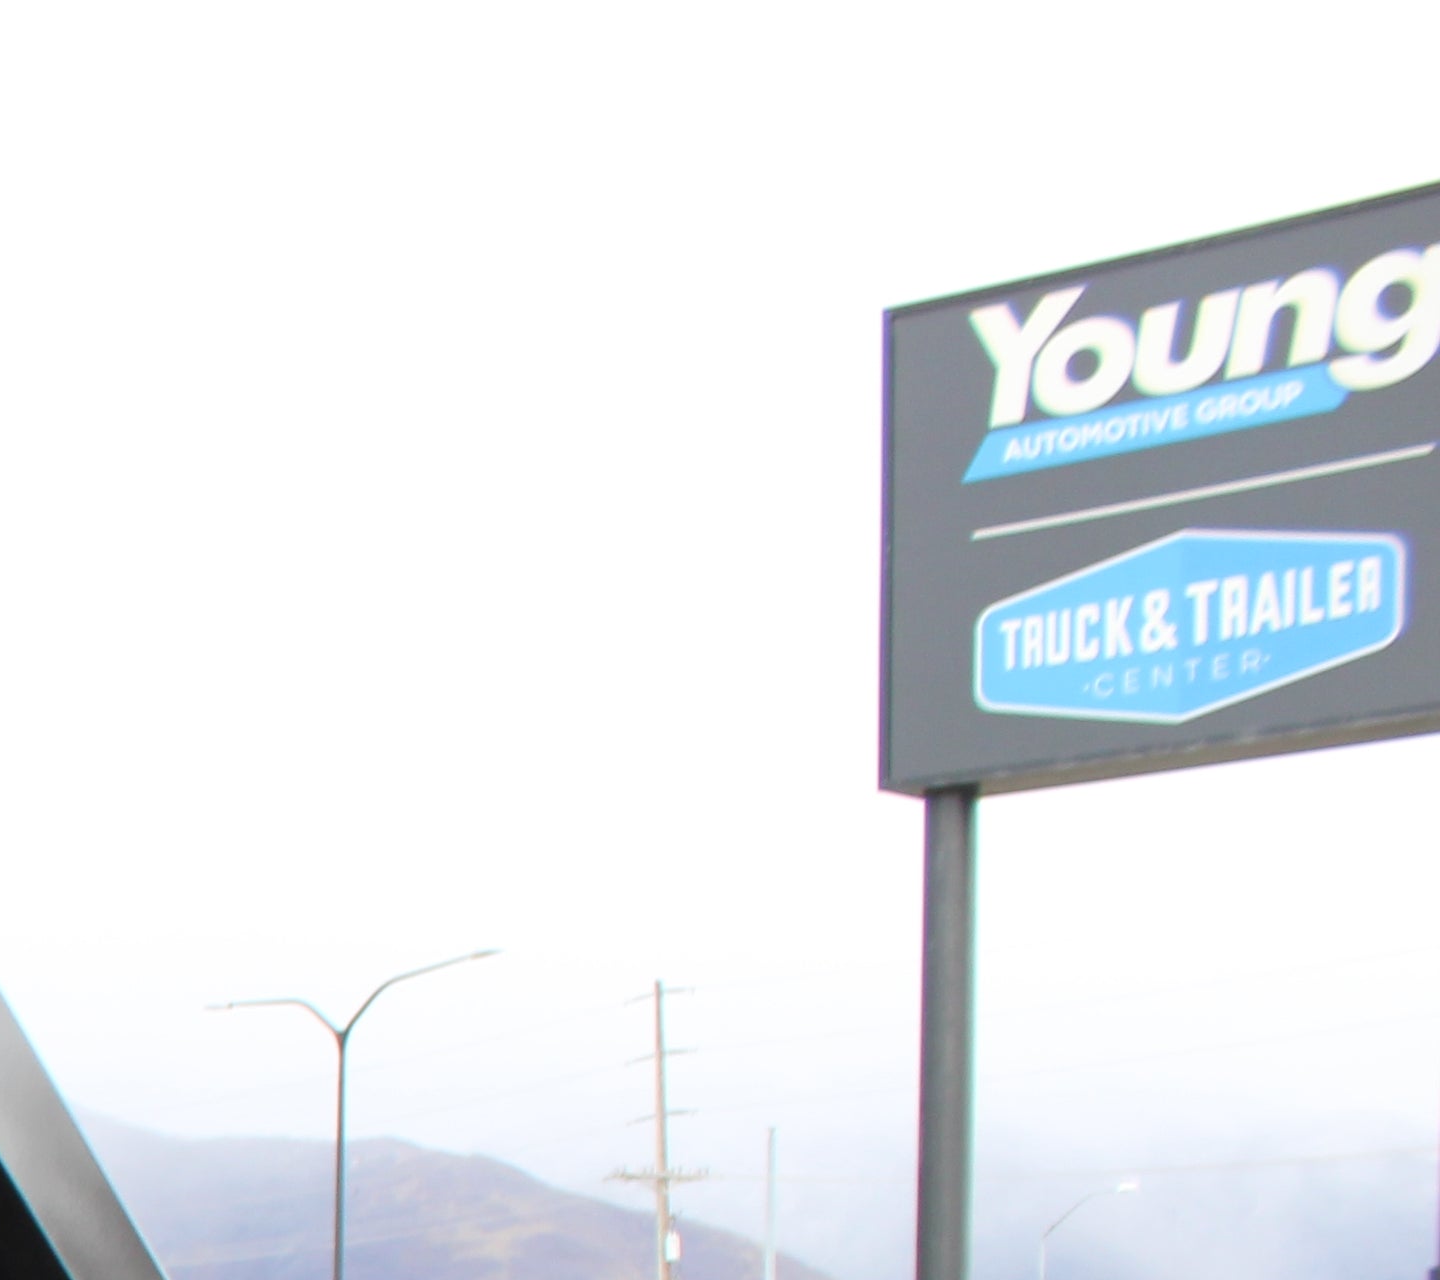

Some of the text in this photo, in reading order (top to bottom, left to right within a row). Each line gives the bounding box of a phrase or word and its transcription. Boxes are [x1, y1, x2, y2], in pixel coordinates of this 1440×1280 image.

[968, 242, 1440, 431] Young
[1001, 381, 1305, 466] AUTOMOTIVE GROUP
[999, 555, 1383, 671] TRUCK & TRAILER
[1092, 648, 1264, 698] CENTER
